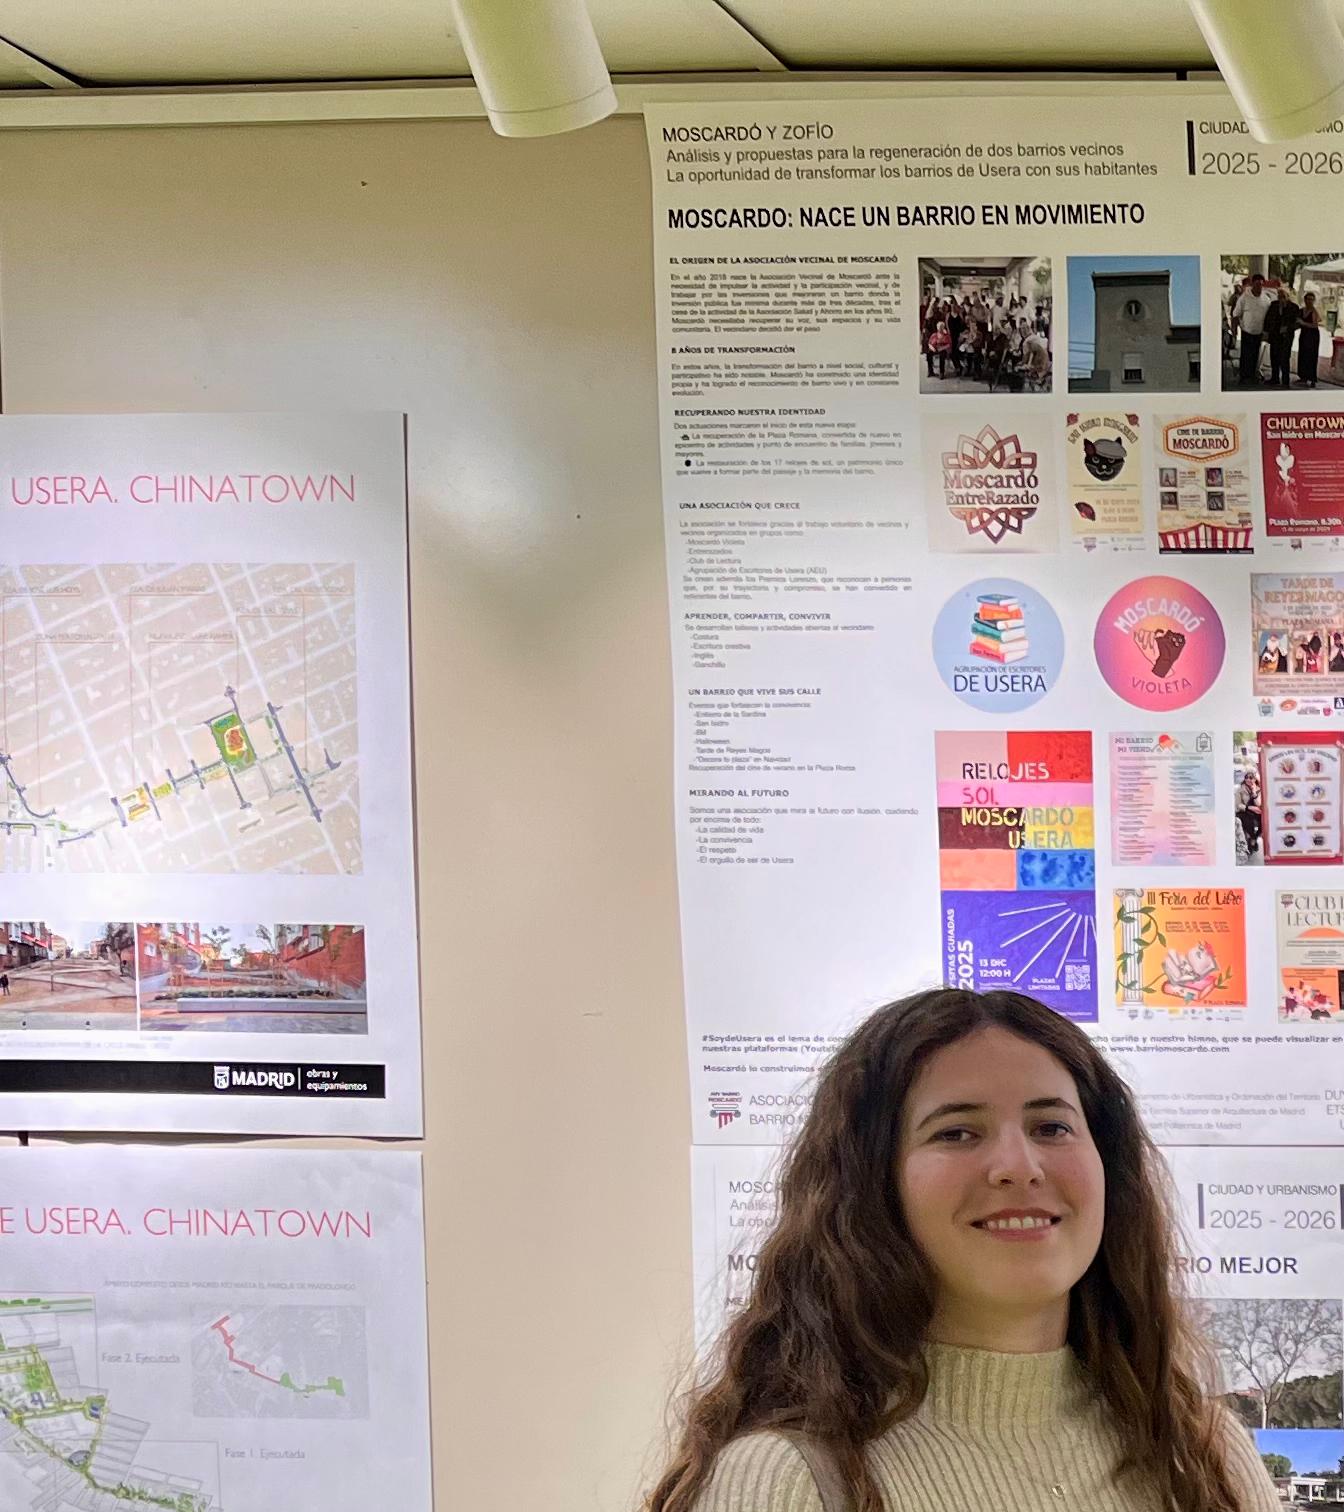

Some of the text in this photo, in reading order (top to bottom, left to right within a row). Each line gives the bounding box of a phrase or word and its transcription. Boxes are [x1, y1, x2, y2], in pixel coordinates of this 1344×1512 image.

[663, 122, 833, 143] MOSCARDÓ Y ZOFÍO
[667, 143, 1124, 165] Análisis y propuestas para la regeneración de dos barrios vecinos
[1203, 152, 1260, 175] 2025
[1285, 152, 1343, 175] 2026
[667, 162, 1157, 184] La oportunidad de transformar los barrios de Usera con sus habitantes
[669, 203, 1144, 228] MOSCARDO: NACE UN BARRIO EN MOVIMIENTO
[1172, 435, 1230, 450] MOSCARDÓ
[943, 468, 1038, 488] Moscardó
[11, 474, 355, 506] USERA. CHINATOWN
[946, 491, 1040, 506] EntreRazado
[1113, 598, 1205, 634] MOSCARDÓ
[954, 675, 1047, 692] DE USERA
[1132, 677, 1192, 694] VIOLETA
[962, 762, 1050, 780] RELOJES
[1008, 830, 1073, 849] USERA
[232, 1071, 295, 1089] MADRID
[1209, 1184, 1337, 1195] CIUDAD Y URBANISMO
[25, 1208, 372, 1239] USERA. CHINATOWN
[1210, 1210, 1262, 1229] 2025
[1284, 1210, 1336, 1229] 2026
[1220, 1257, 1298, 1274] MEJOR
